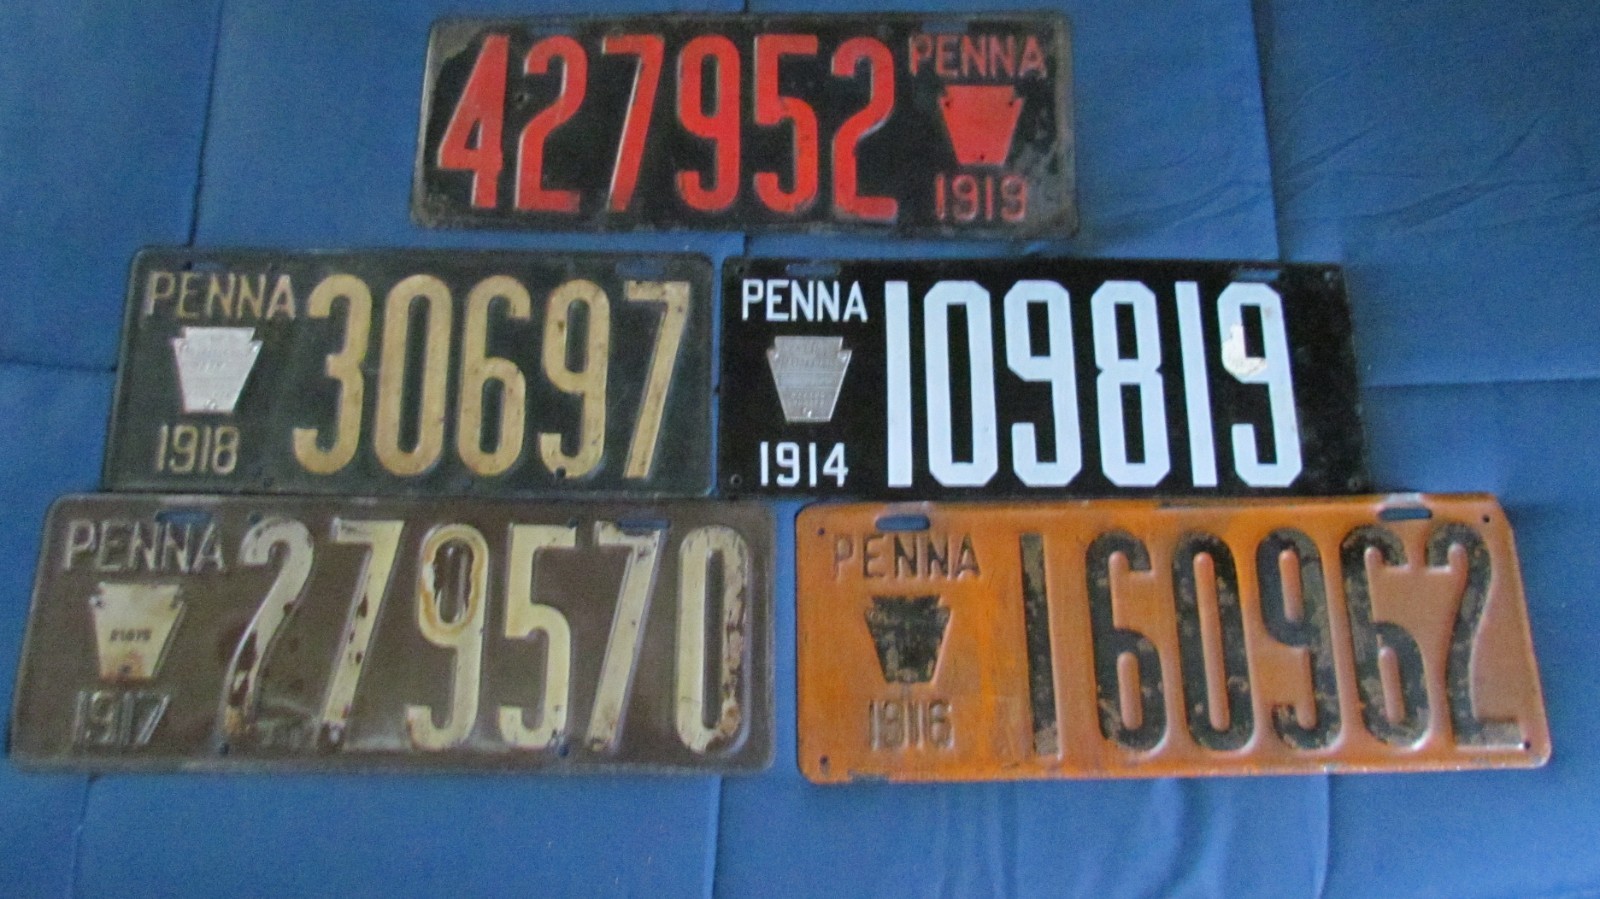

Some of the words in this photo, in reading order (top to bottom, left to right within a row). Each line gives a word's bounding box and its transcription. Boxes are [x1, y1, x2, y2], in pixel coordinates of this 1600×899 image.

[907, 34, 1049, 79] PENNA
[436, 34, 899, 221] 427952
[934, 173, 1028, 222] 1919
[143, 271, 297, 321] PENNA
[741, 279, 868, 322] PENNA
[292, 273, 691, 480] 30697
[884, 280, 1303, 489] 109819
[155, 424, 241, 475] 1918
[759, 441, 849, 488] 1914
[64, 518, 228, 573] PENNA
[832, 532, 985, 580] PENNA
[220, 515, 751, 754] 279570
[1019, 523, 1527, 761] 160962
[73, 690, 171, 746] 1917
